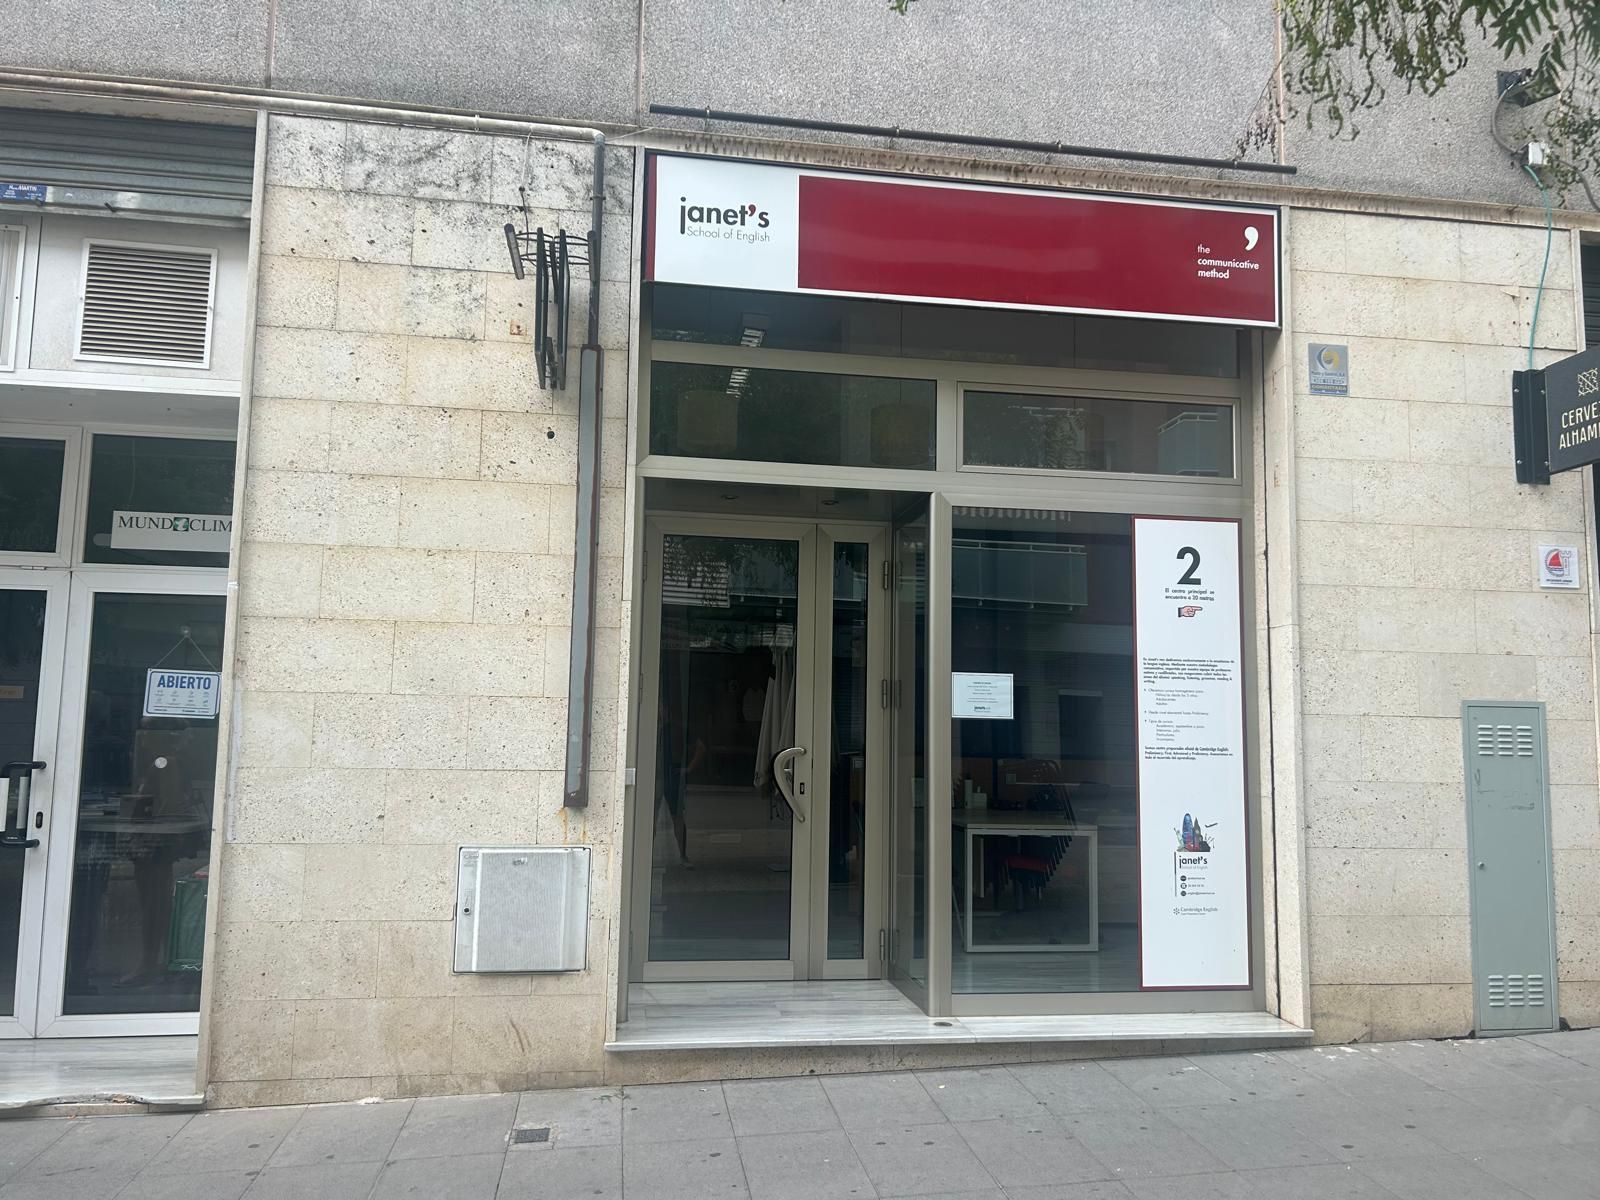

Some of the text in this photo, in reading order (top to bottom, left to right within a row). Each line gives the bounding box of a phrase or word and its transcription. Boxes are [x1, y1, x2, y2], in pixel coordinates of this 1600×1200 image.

[680, 196, 770, 235] janet's
[687, 226, 770, 244] School of English
[1197, 243, 1211, 254] the
[1197, 258, 1260, 270] communicative
[1197, 268, 1230, 279] method
[1176, 546, 1202, 586] 2
[157, 675, 211, 690] ABIERTO
[1179, 855, 1208, 869] janet's
